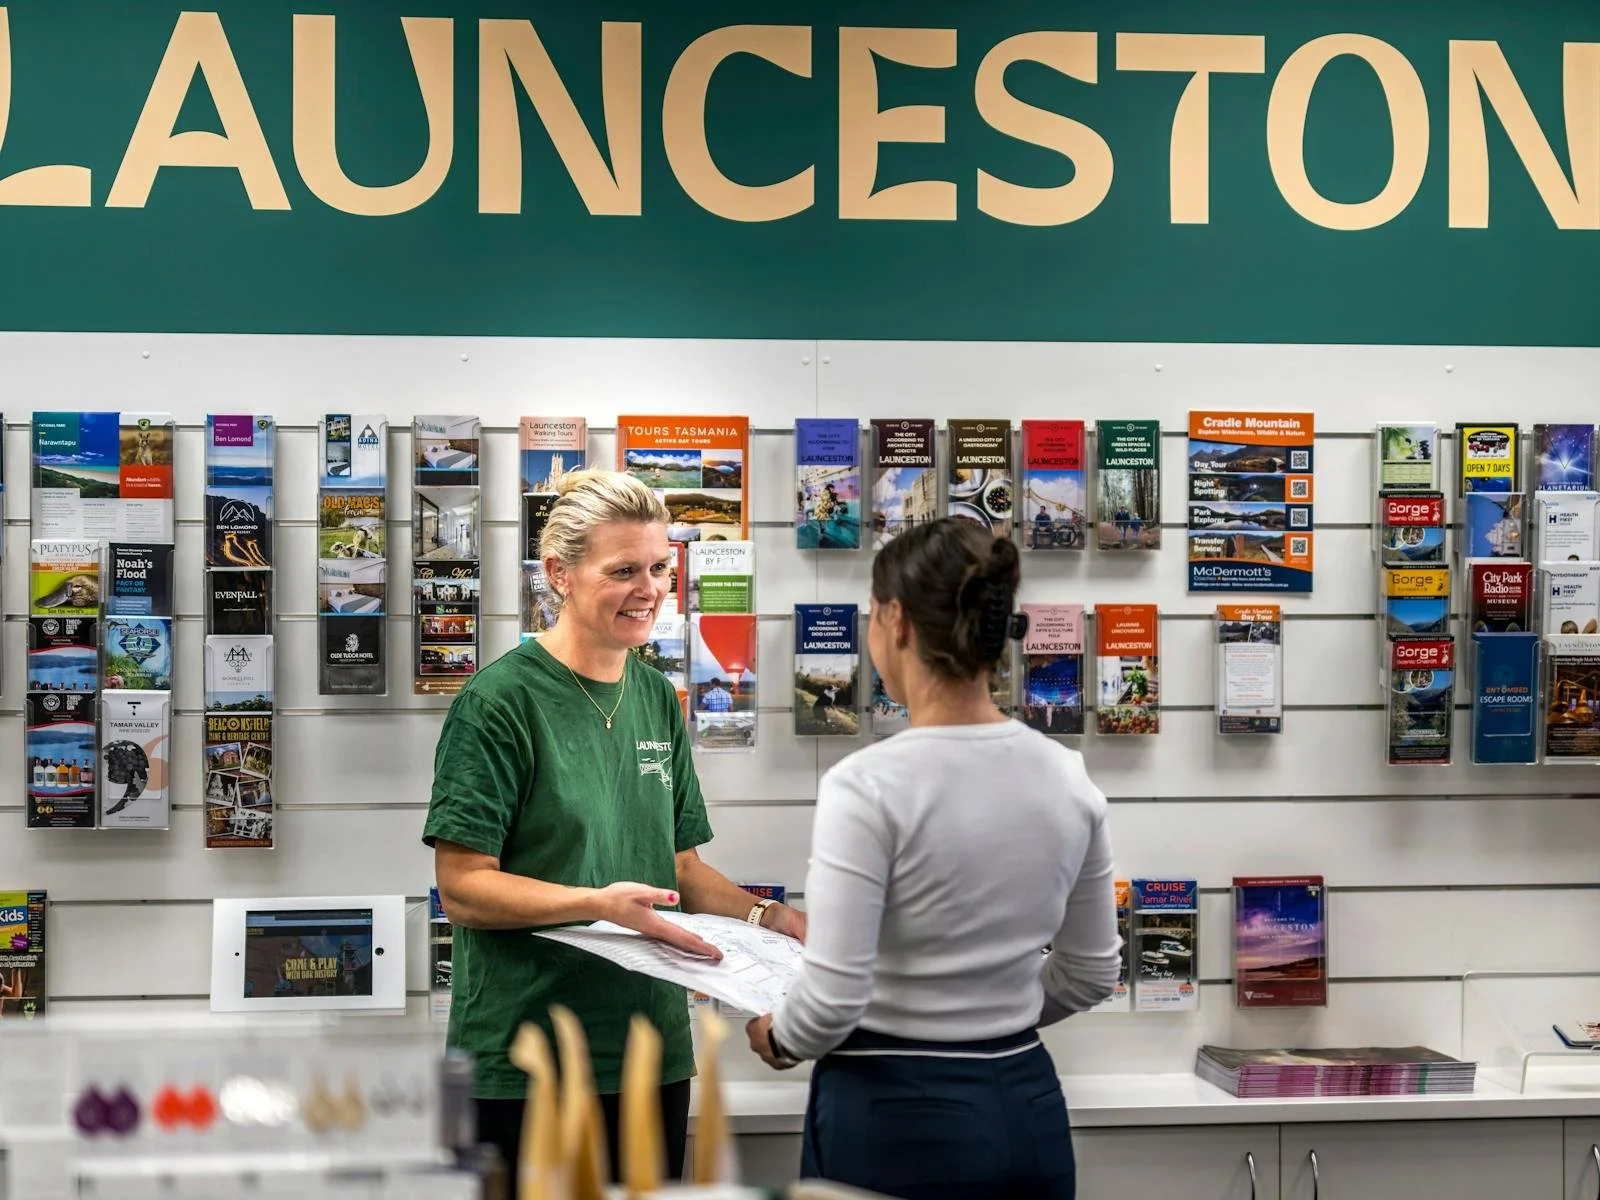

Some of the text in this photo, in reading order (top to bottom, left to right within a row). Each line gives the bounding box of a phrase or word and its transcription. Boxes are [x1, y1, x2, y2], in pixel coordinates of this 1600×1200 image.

[0, 6, 1600, 231] LAUNCESTON
[529, 422, 577, 430] Launceston
[1203, 417, 1300, 429] Cradle Mountain
[628, 426, 738, 436] TOURS TASMANIA
[879, 456, 931, 464] LAUNCESTON
[957, 456, 1006, 464] LAUNCESTON
[1467, 464, 1511, 472] OPEN 7 DAYS
[1194, 480, 1214, 488] Night
[324, 496, 380, 509] OLD MAC'S
[1388, 502, 1430, 516] Gorge
[40, 544, 91, 555] PLATYPUS
[695, 548, 746, 556] LAUNCESTON
[117, 559, 152, 569] Noah's
[705, 557, 715, 565] BY
[117, 570, 147, 578] Flood
[1193, 567, 1272, 576] McDermott's
[1392, 574, 1433, 587] Gorge
[1483, 571, 1522, 584] City Park
[1483, 583, 1508, 594] Radio
[215, 591, 257, 602] EVENFALL
[1397, 646, 1438, 659] Gorge
[1146, 883, 1186, 892] CRUISE
[1141, 895, 1192, 904] Tamar River
[286, 959, 308, 970] COME
[318, 958, 337, 969] PLAY
